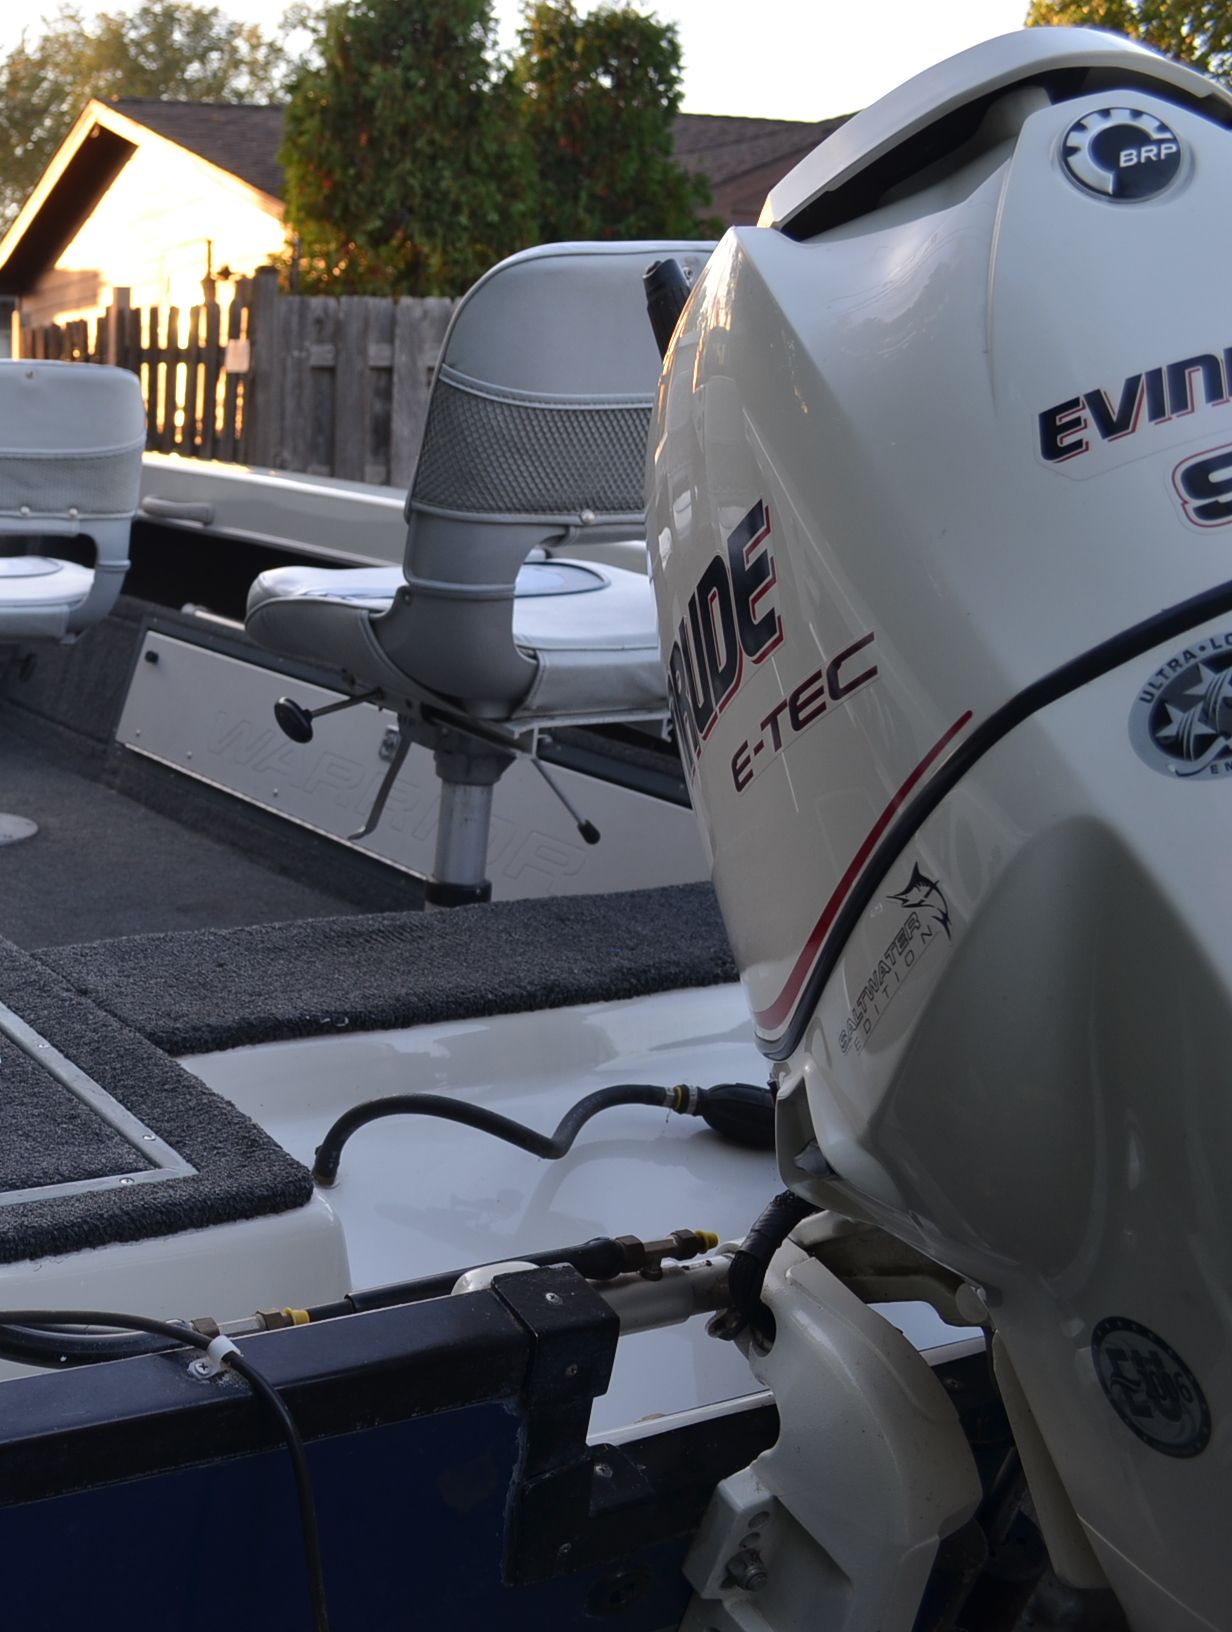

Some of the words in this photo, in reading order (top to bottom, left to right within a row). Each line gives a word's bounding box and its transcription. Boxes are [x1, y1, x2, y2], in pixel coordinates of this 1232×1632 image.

[1119, 142, 1178, 168] BRP
[1038, 347, 1232, 464] EVIN
[668, 498, 785, 778] RUDE
[1139, 649, 1198, 704] ULTRA
[730, 629, 880, 794] E-TEC
[839, 911, 921, 1055] SALTWATER
[853, 924, 933, 1056] EDITION
